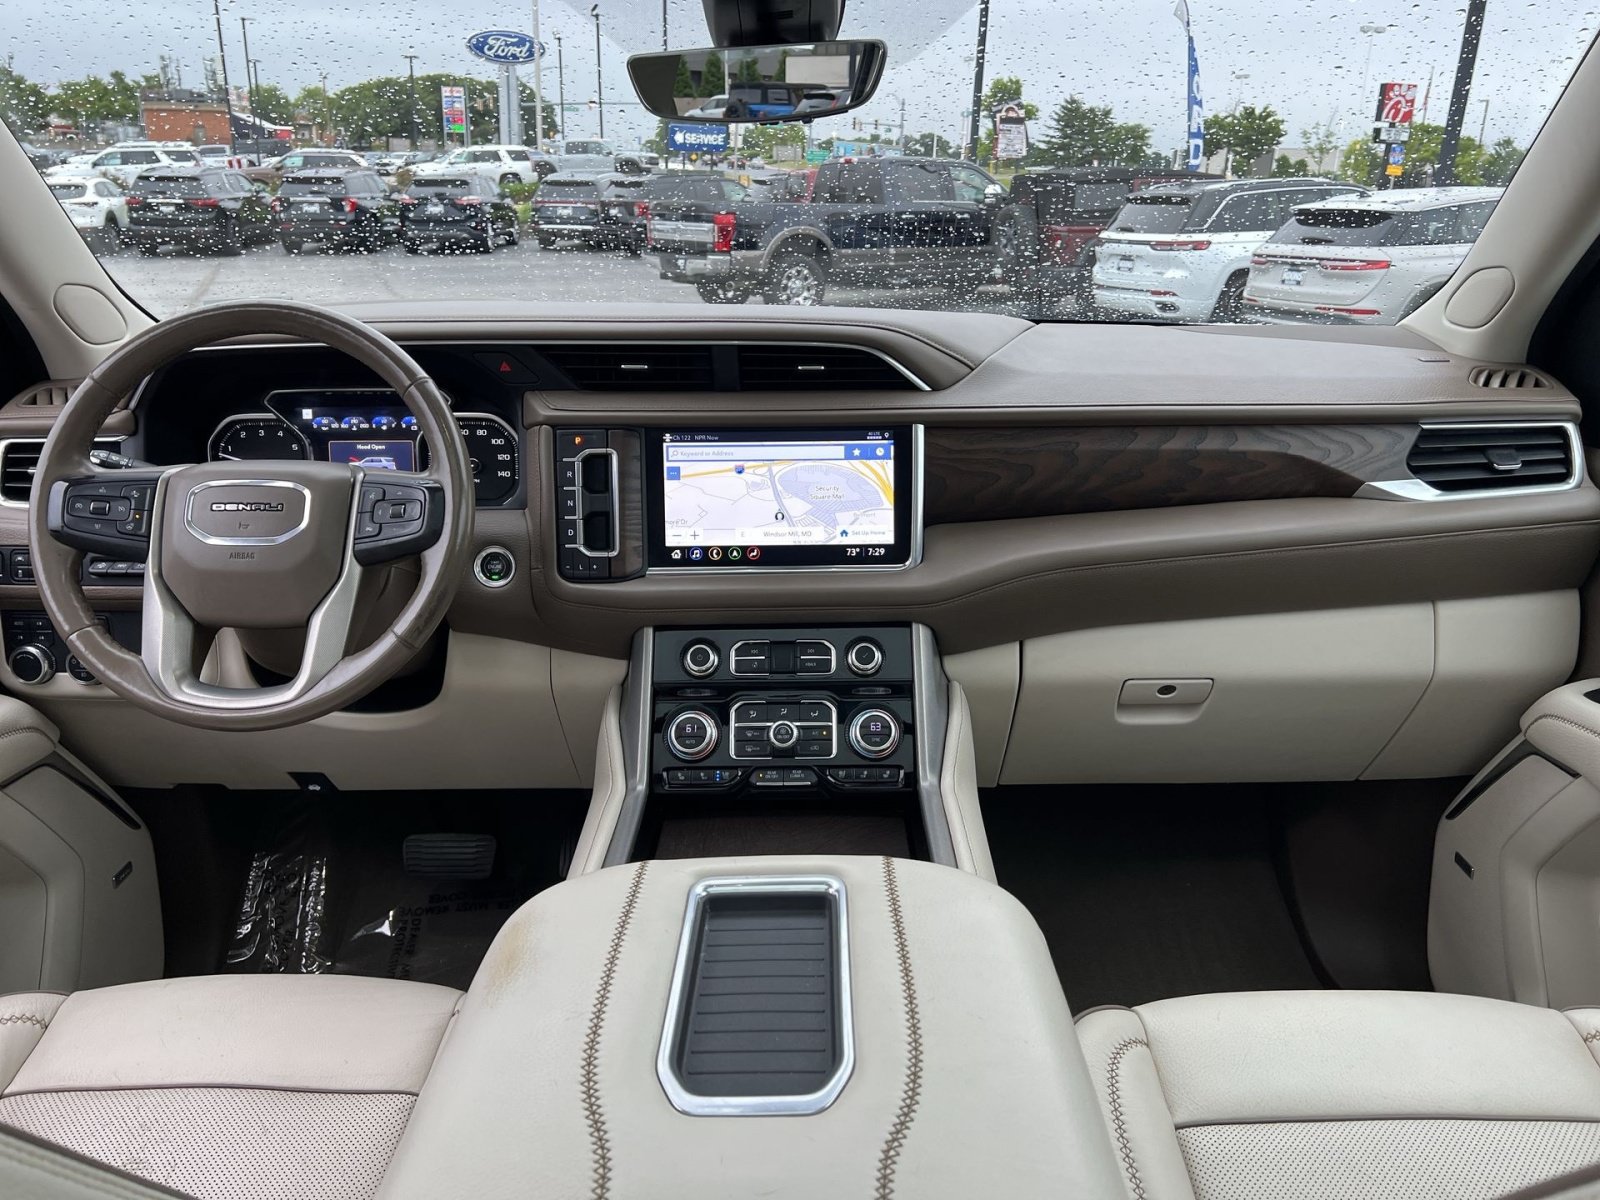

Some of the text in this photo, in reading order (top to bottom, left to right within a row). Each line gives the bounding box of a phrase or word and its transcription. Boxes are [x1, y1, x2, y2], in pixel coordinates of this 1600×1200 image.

[484, 36, 530, 58] Ford
[684, 132, 725, 145] SERVICE
[211, 503, 283, 511] DENALI
[686, 724, 697, 733] 61
[871, 723, 881, 731] 63
